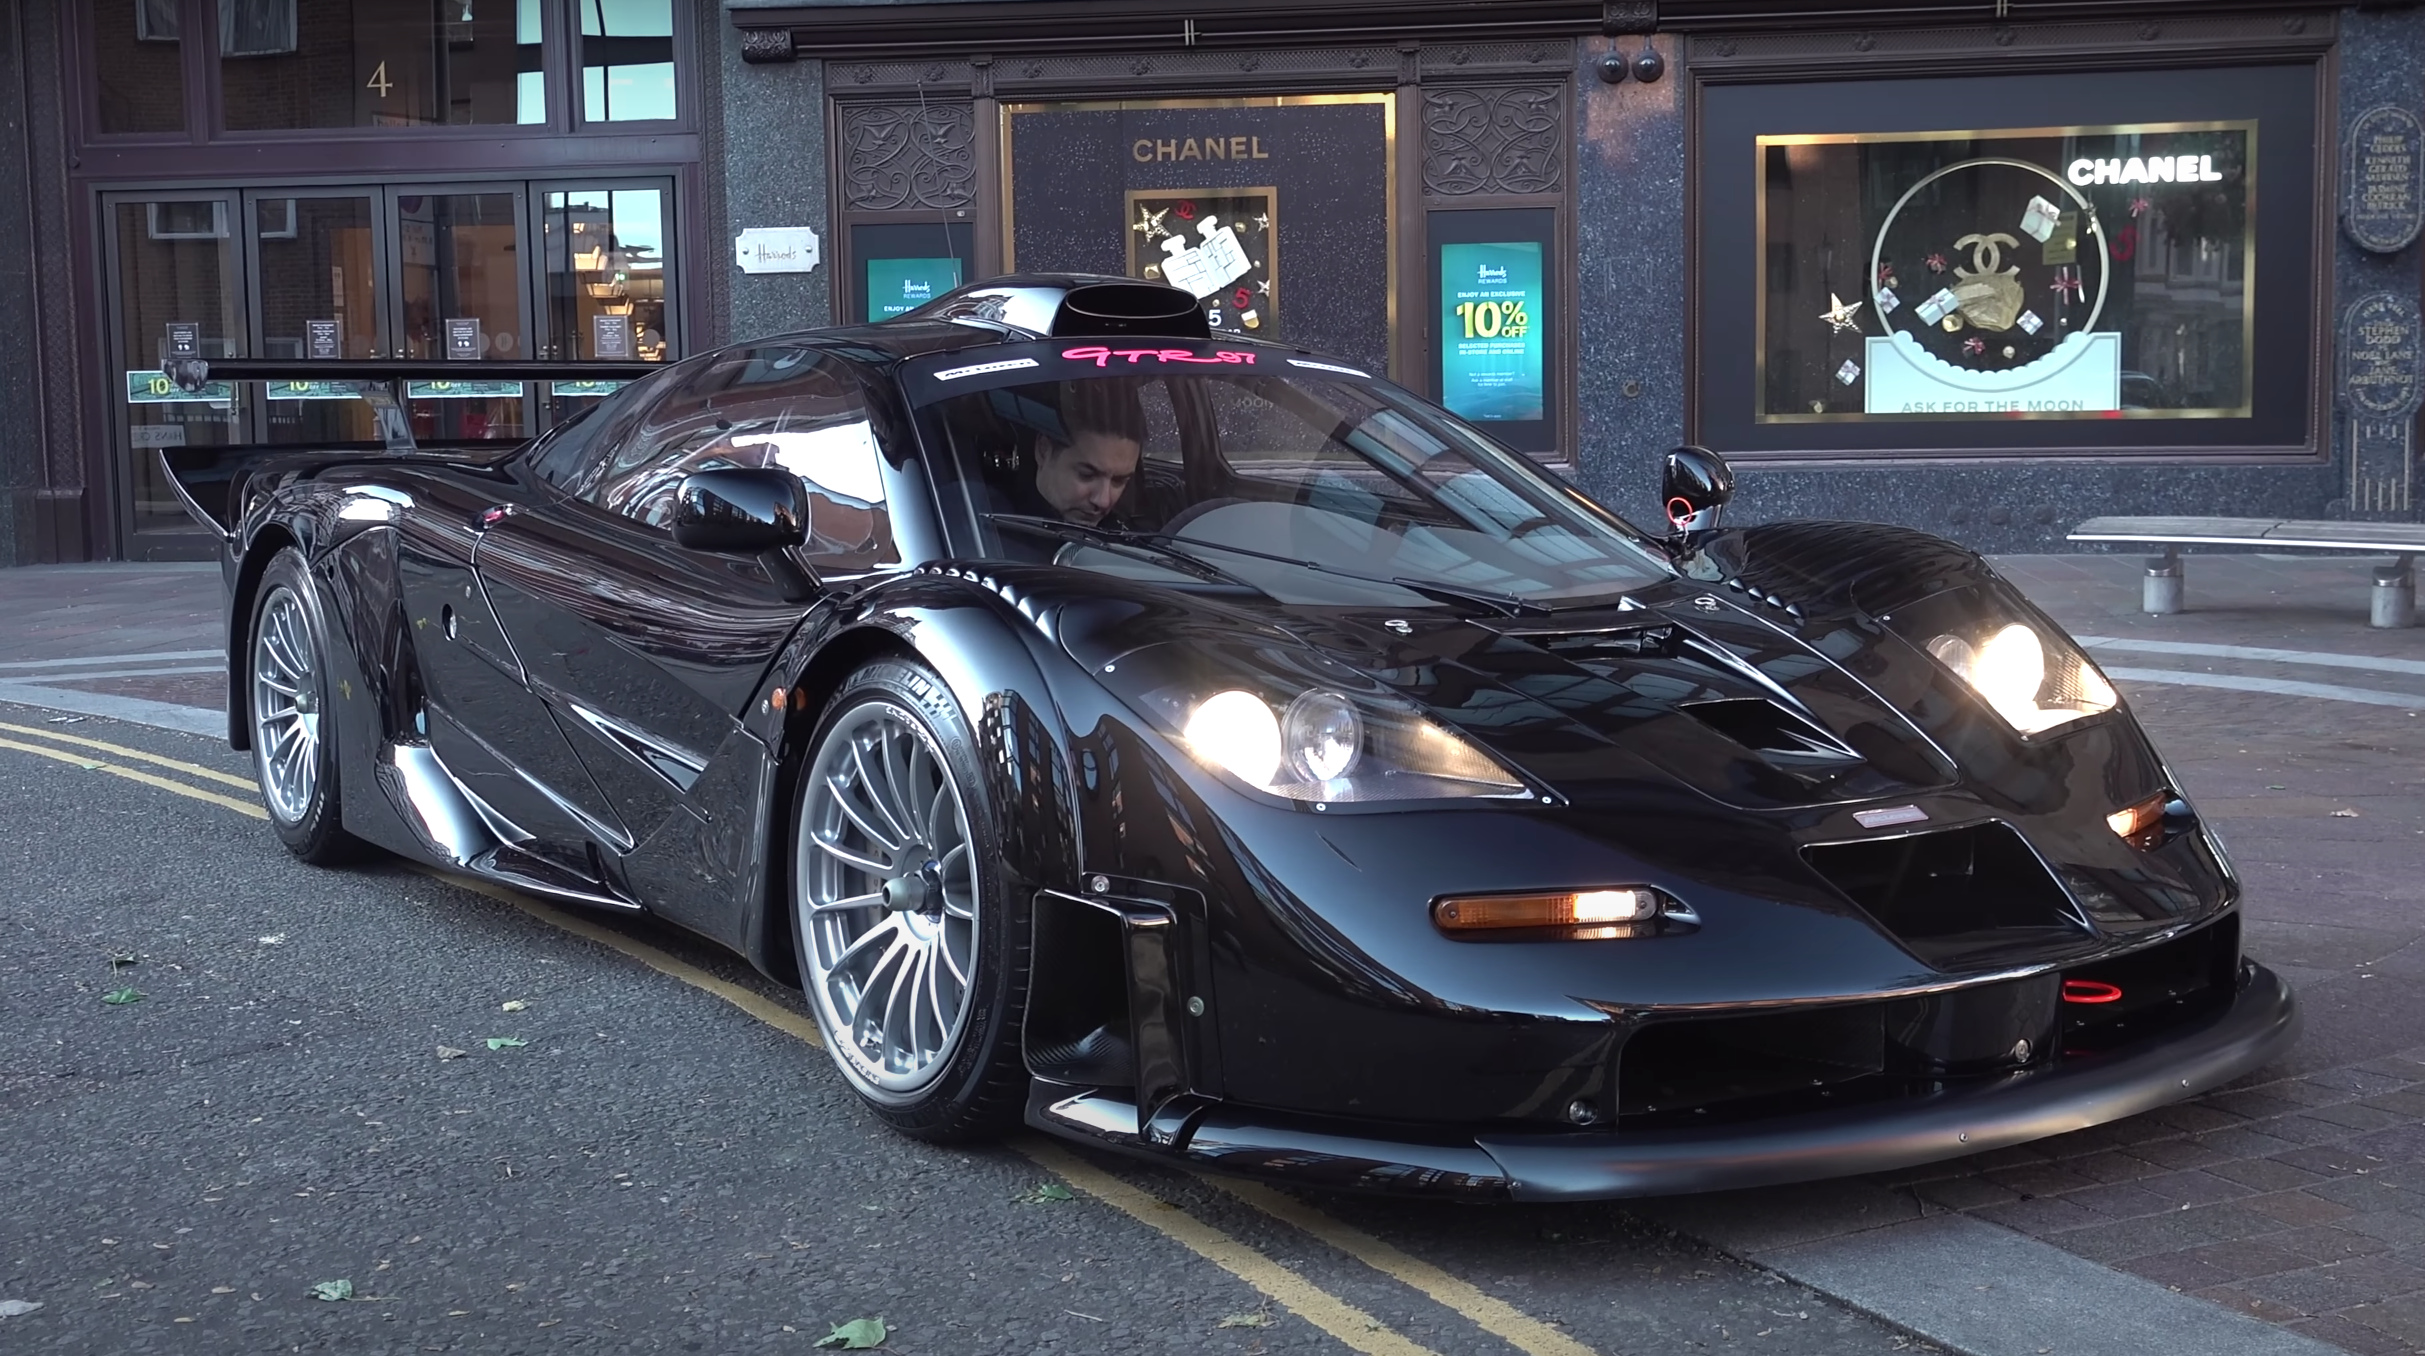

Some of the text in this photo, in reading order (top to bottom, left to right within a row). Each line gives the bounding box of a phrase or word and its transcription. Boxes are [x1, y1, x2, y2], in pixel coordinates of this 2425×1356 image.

[366, 60, 393, 98] 4
[1132, 136, 1270, 163] CHANEL
[2067, 154, 2223, 187] CHANEL
[755, 243, 797, 264] Harrods
[1477, 263, 1508, 279] Harrods
[902, 279, 931, 294] Harrods
[1232, 287, 1252, 309] 5
[1456, 300, 1529, 338] 10%
[1501, 325, 1530, 338] OFF
[2358, 325, 2409, 336] STEPHEN
[2365, 335, 2402, 345] DODD
[2352, 350, 2413, 360] NOEL LANE
[1901, 400, 2084, 413] ASK FOR THE MOON
